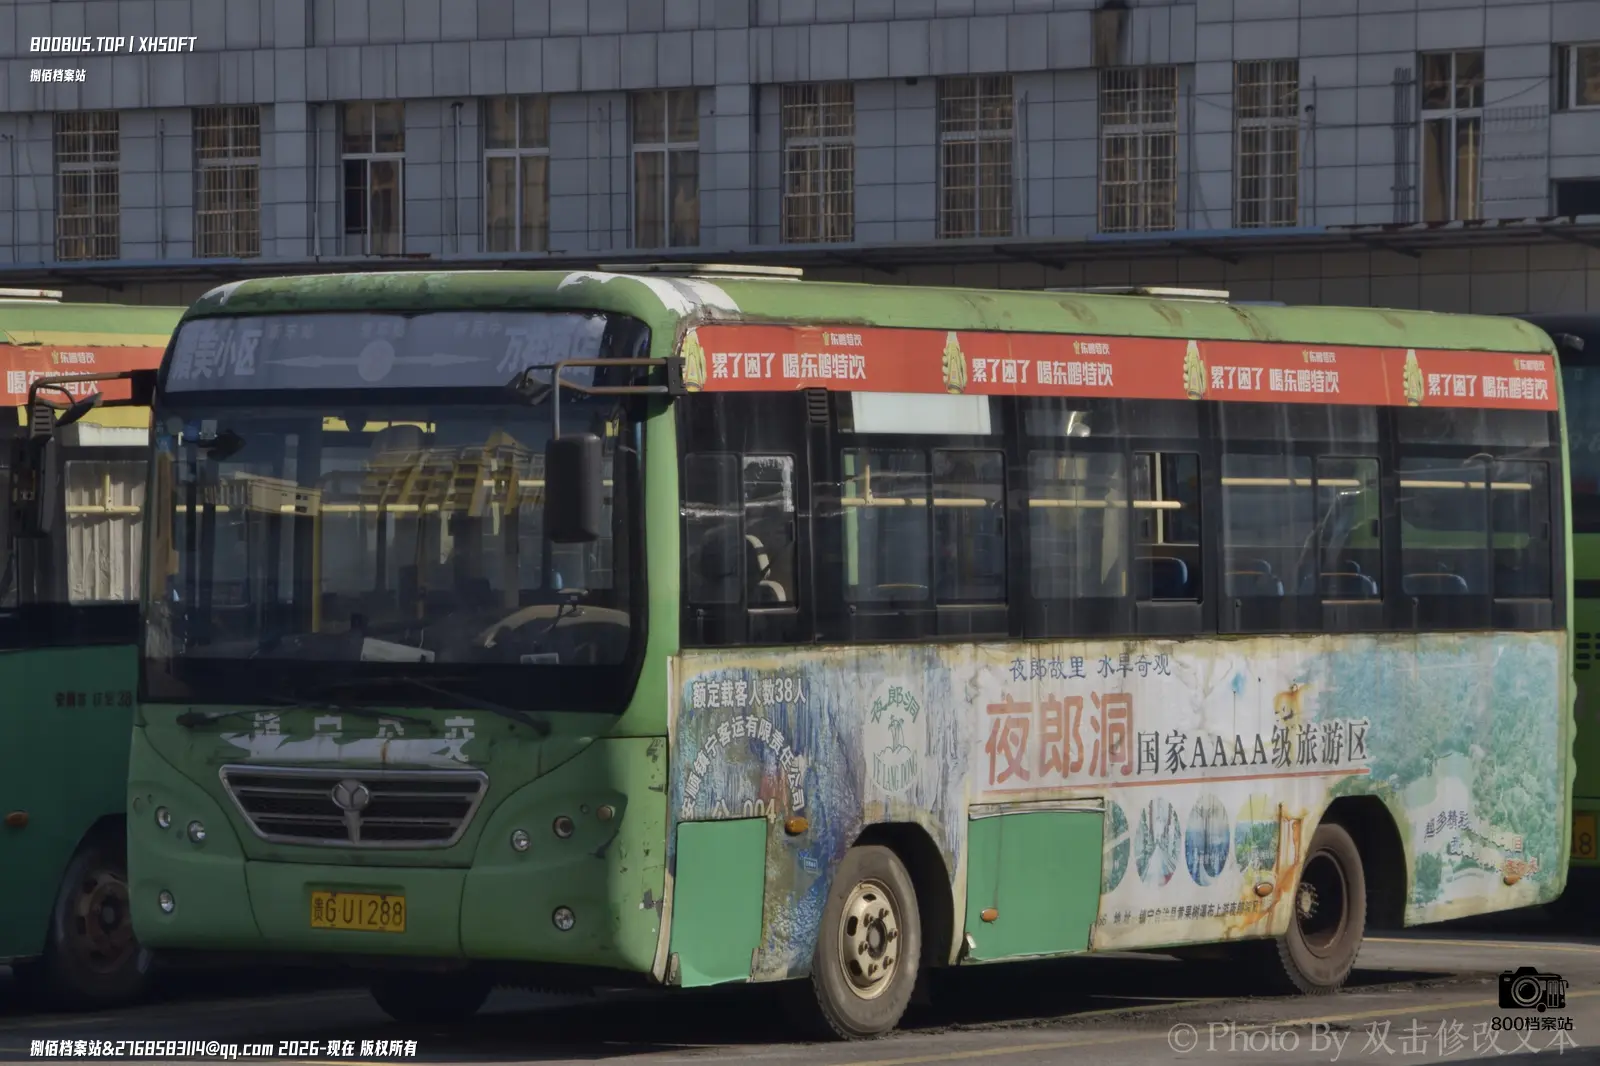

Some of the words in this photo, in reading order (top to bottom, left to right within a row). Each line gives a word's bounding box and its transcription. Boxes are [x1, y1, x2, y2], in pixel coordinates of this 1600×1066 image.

[830, 333, 863, 346] 东鹏特饮
[712, 352, 776, 379] 累了困了
[782, 353, 867, 380] 喝东鹏特饮
[972, 358, 1031, 384] 累了困了
[1036, 360, 1113, 387] 喝东鹏特饮
[1211, 366, 1264, 390] 累了困了
[1269, 368, 1340, 393] 喝东鹏特饮
[1428, 374, 1477, 396] 累了困了
[1482, 375, 1549, 400] 喝东鹏特饮
[1009, 655, 1087, 682] 夜郎故里
[1097, 652, 1171, 679] 水旱奇观
[693, 677, 807, 709] 额定载客人数38人
[984, 691, 1134, 786] 夜郎洞
[1136, 719, 1370, 777] 国家AAAA级旅游区
[681, 714, 805, 820] 安顺镇宁客运有限责任公司
